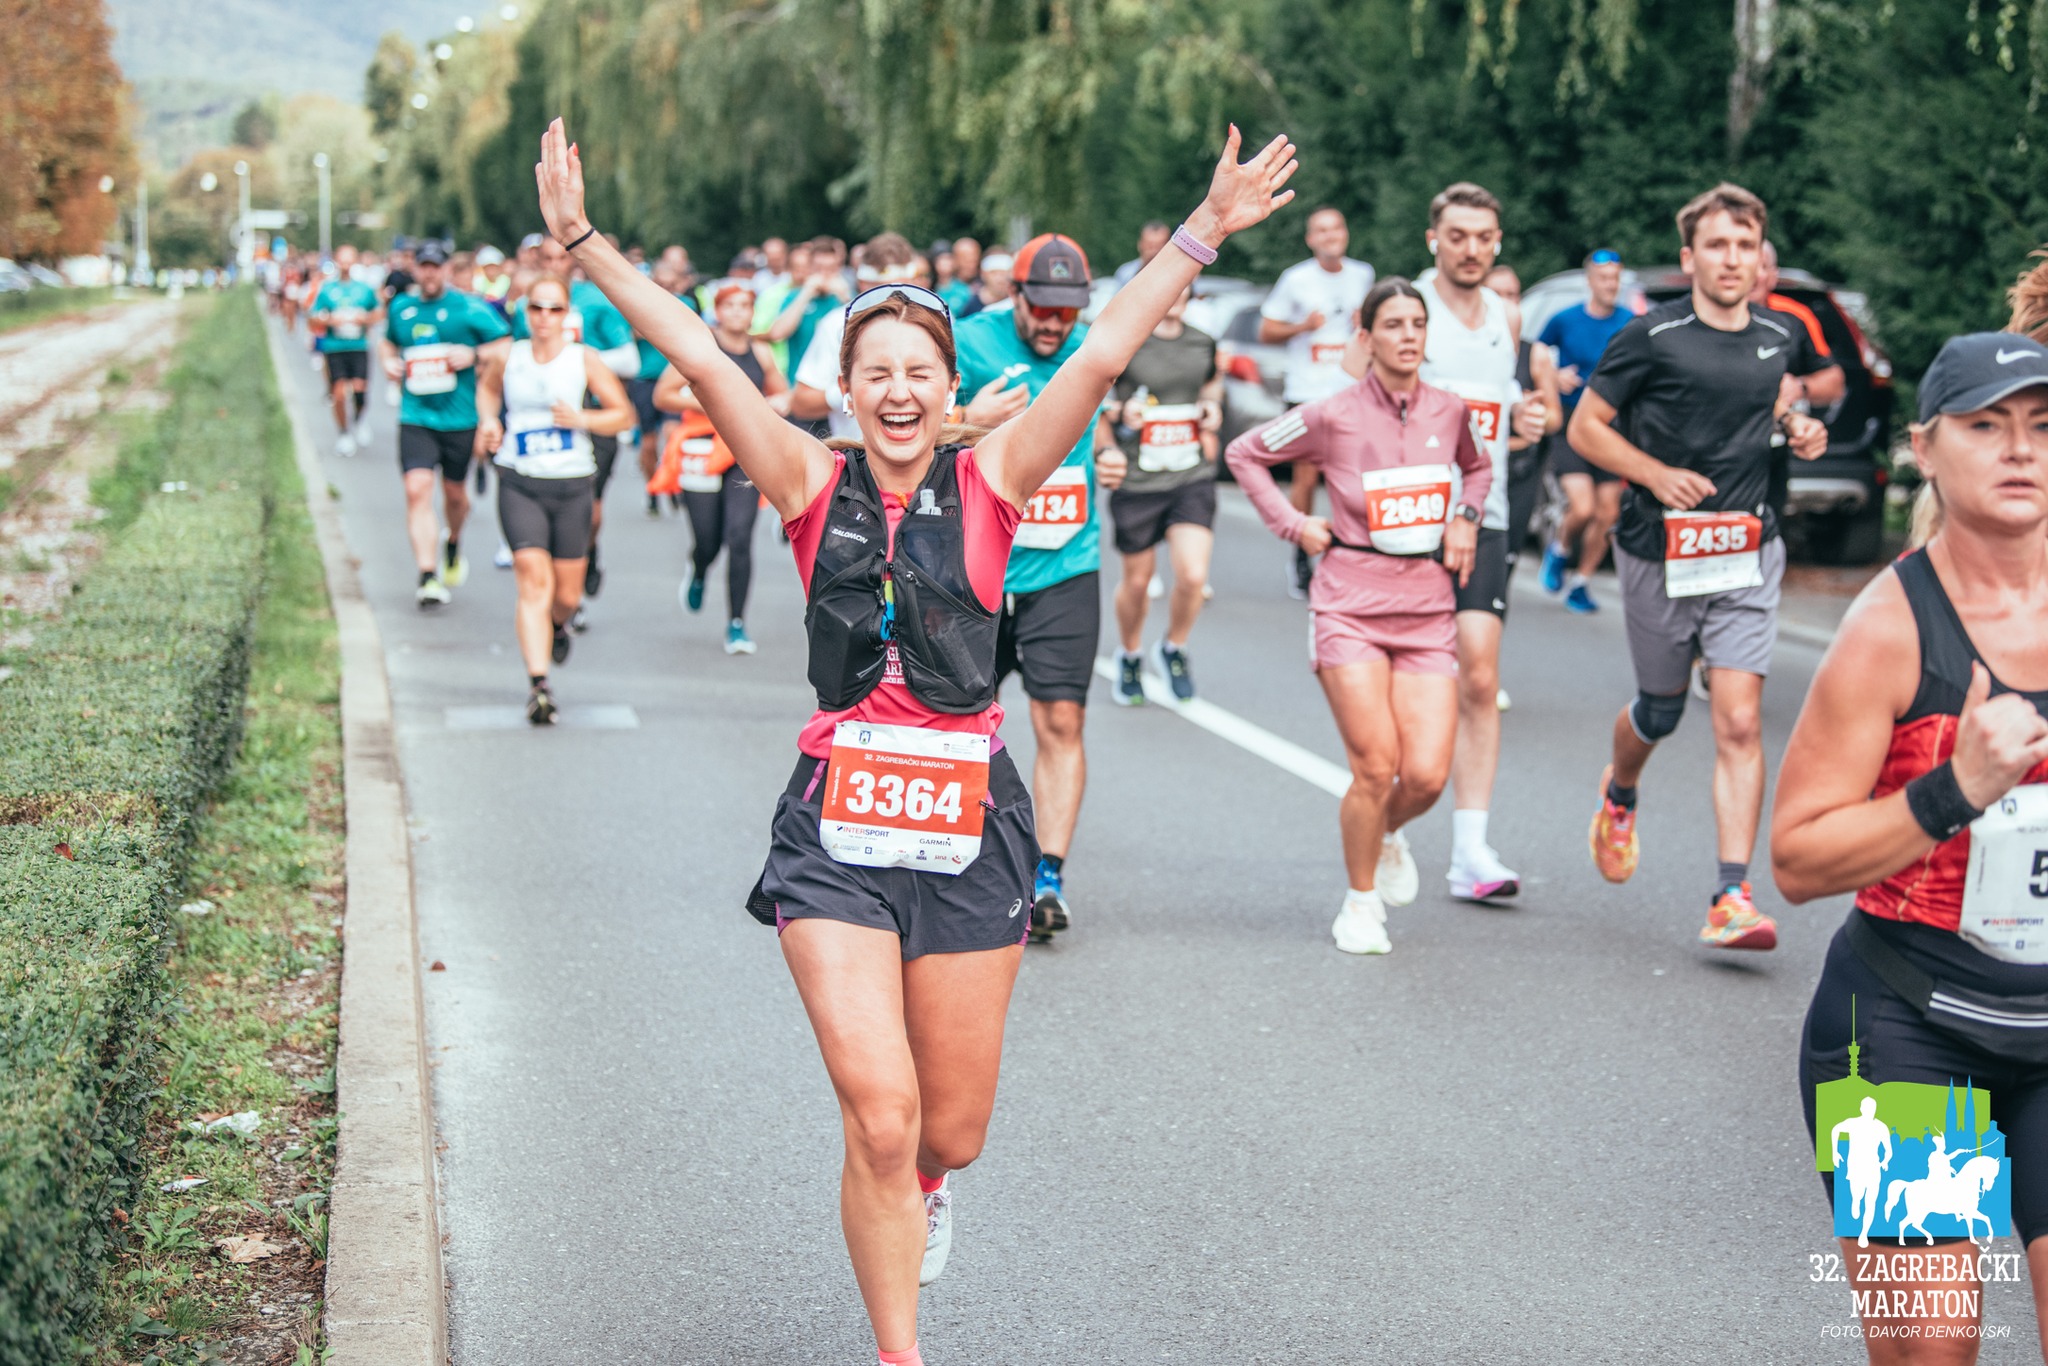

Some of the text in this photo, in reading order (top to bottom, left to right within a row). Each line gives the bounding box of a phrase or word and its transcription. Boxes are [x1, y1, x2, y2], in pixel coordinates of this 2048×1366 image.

[1380, 493, 1445, 526] 2649
[831, 528, 868, 544] SALOMON
[1679, 525, 1748, 555] 2435
[920, 761, 955, 770] MARATON
[845, 770, 962, 824] 3364
[843, 826, 890, 838] INTERSPORT
[919, 838, 951, 847] GARMIN
